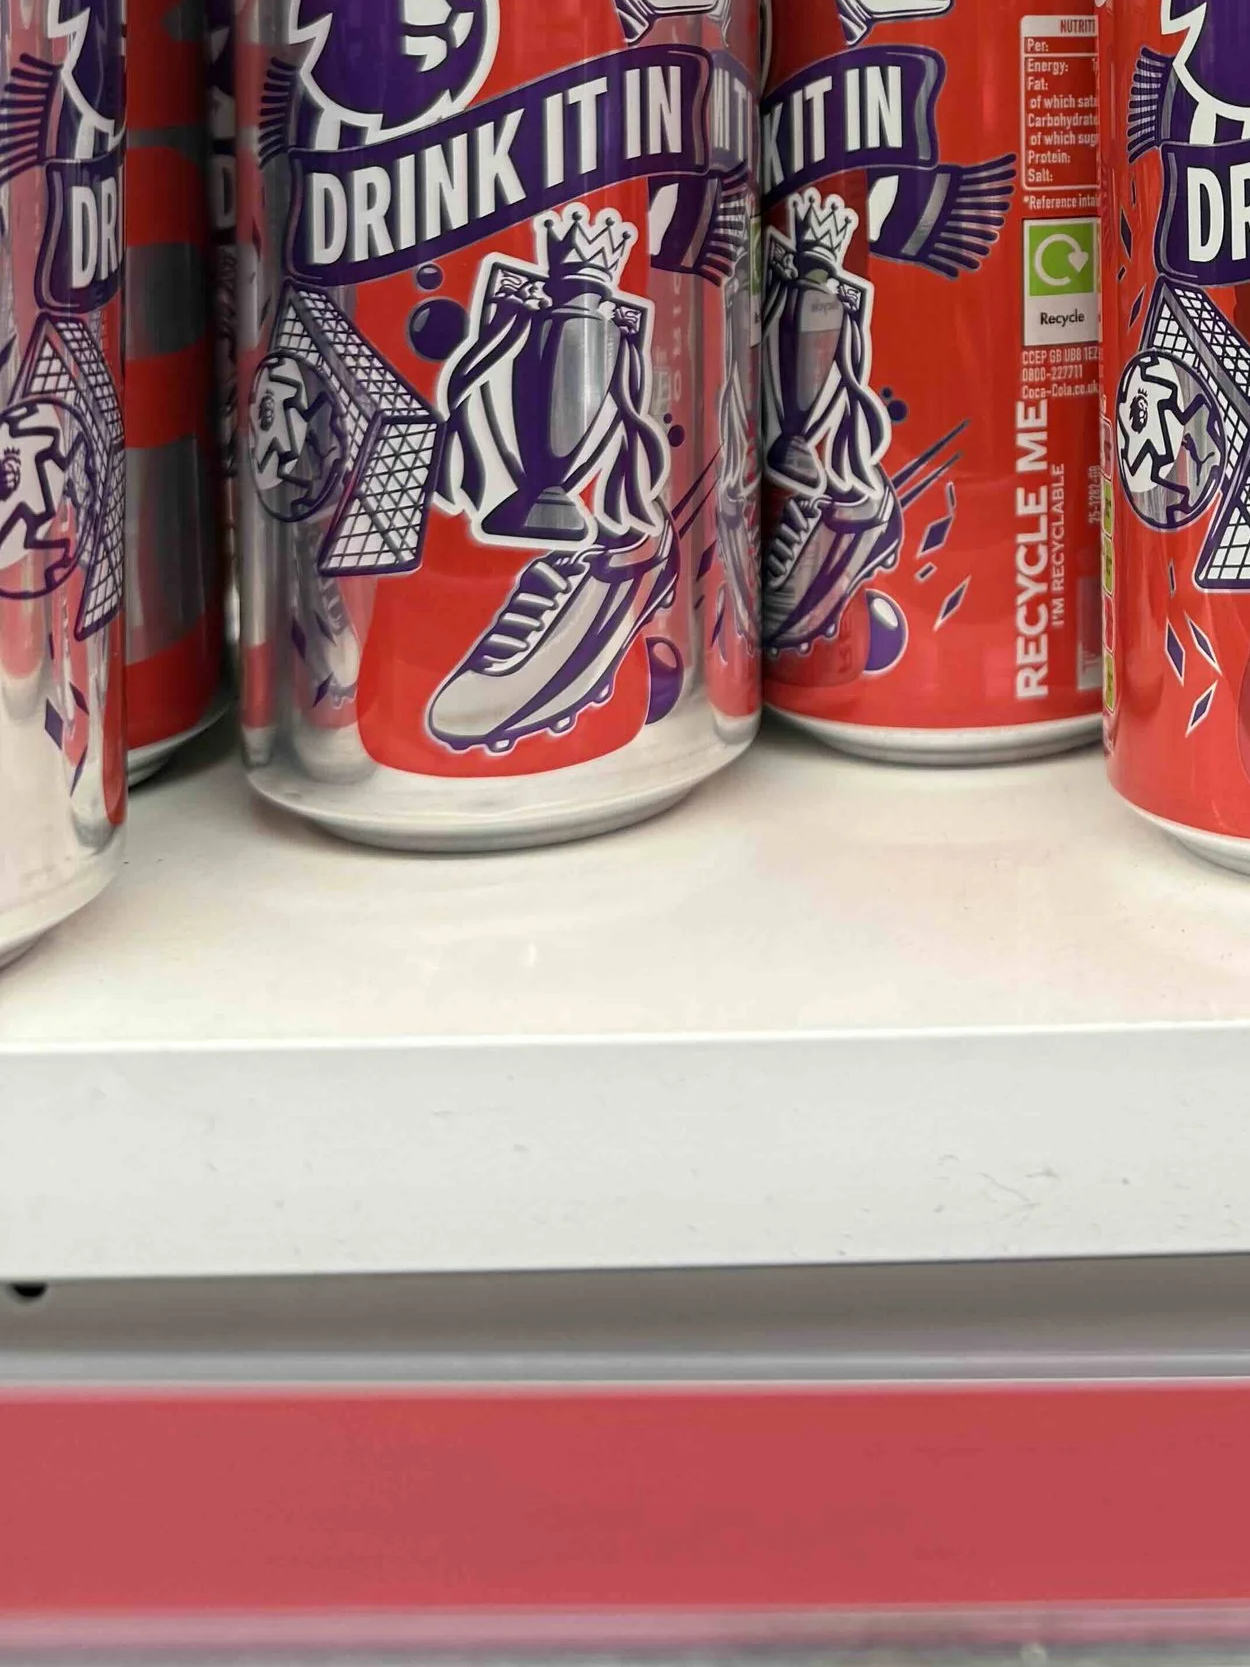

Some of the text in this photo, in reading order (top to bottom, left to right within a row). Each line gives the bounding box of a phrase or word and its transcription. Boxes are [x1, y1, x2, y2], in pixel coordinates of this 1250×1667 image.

[1060, 19, 1096, 34] NUTRITI
[1027, 37, 1049, 52] Per:
[1027, 58, 1069, 75] Energy:
[1027, 77, 1049, 91] Fat:
[1030, 95, 1041, 109] of
[1044, 95, 1075, 109] which
[791, 75, 832, 174] IT
[844, 65, 902, 152] IN
[1030, 132, 1041, 146] of
[1044, 131, 1075, 146] which
[1027, 149, 1071, 164] Protein:
[306, 111, 527, 266] DRINK
[542, 77, 609, 187] IT
[624, 65, 683, 158] IN
[1027, 168, 1053, 183] Salt:
[72, 177, 127, 289] DRI
[1040, 308, 1086, 326] Recycle
[1022, 350, 1047, 365] CCEP
[1049, 348, 1062, 363] GB
[1051, 463, 1065, 594] RECYCLABLE
[1015, 399, 1049, 702] RECYCLE ME
